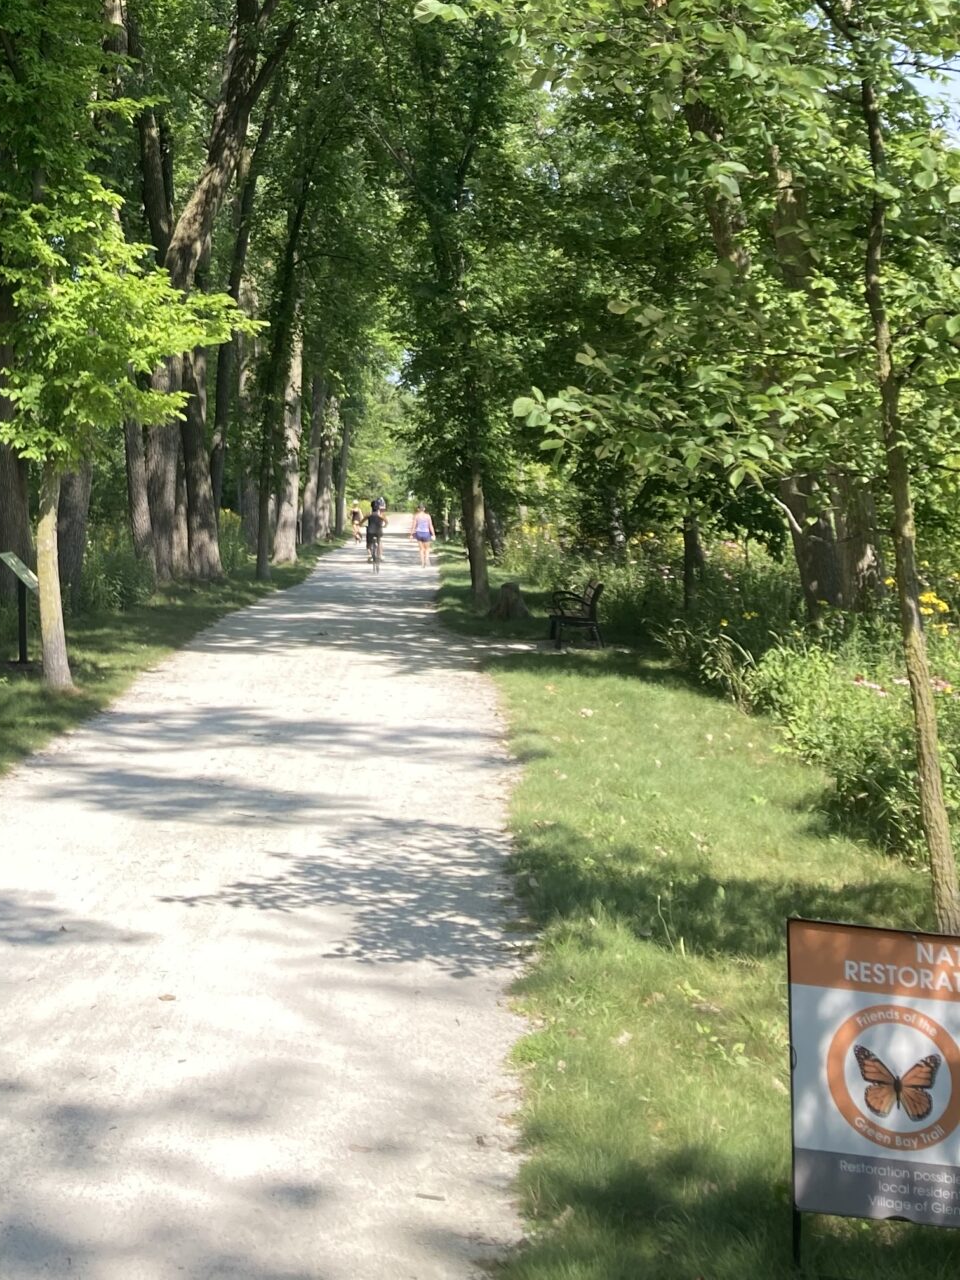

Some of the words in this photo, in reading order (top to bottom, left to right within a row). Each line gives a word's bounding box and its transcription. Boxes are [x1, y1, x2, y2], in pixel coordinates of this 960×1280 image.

[844, 960, 960, 993] RESTORAT
[856, 1009, 900, 1027] Friends
[903, 1013, 917, 1023] of
[919, 1017, 938, 1037] the
[855, 1117, 891, 1145] Green
[895, 1135, 918, 1149] Bay
[920, 1124, 945, 1144] Trail
[840, 1160, 910, 1179] Restoration
[878, 1181, 910, 1194] local
[913, 1186, 960, 1200] residen
[868, 1194, 912, 1212] Village
[915, 1201, 928, 1212] of
